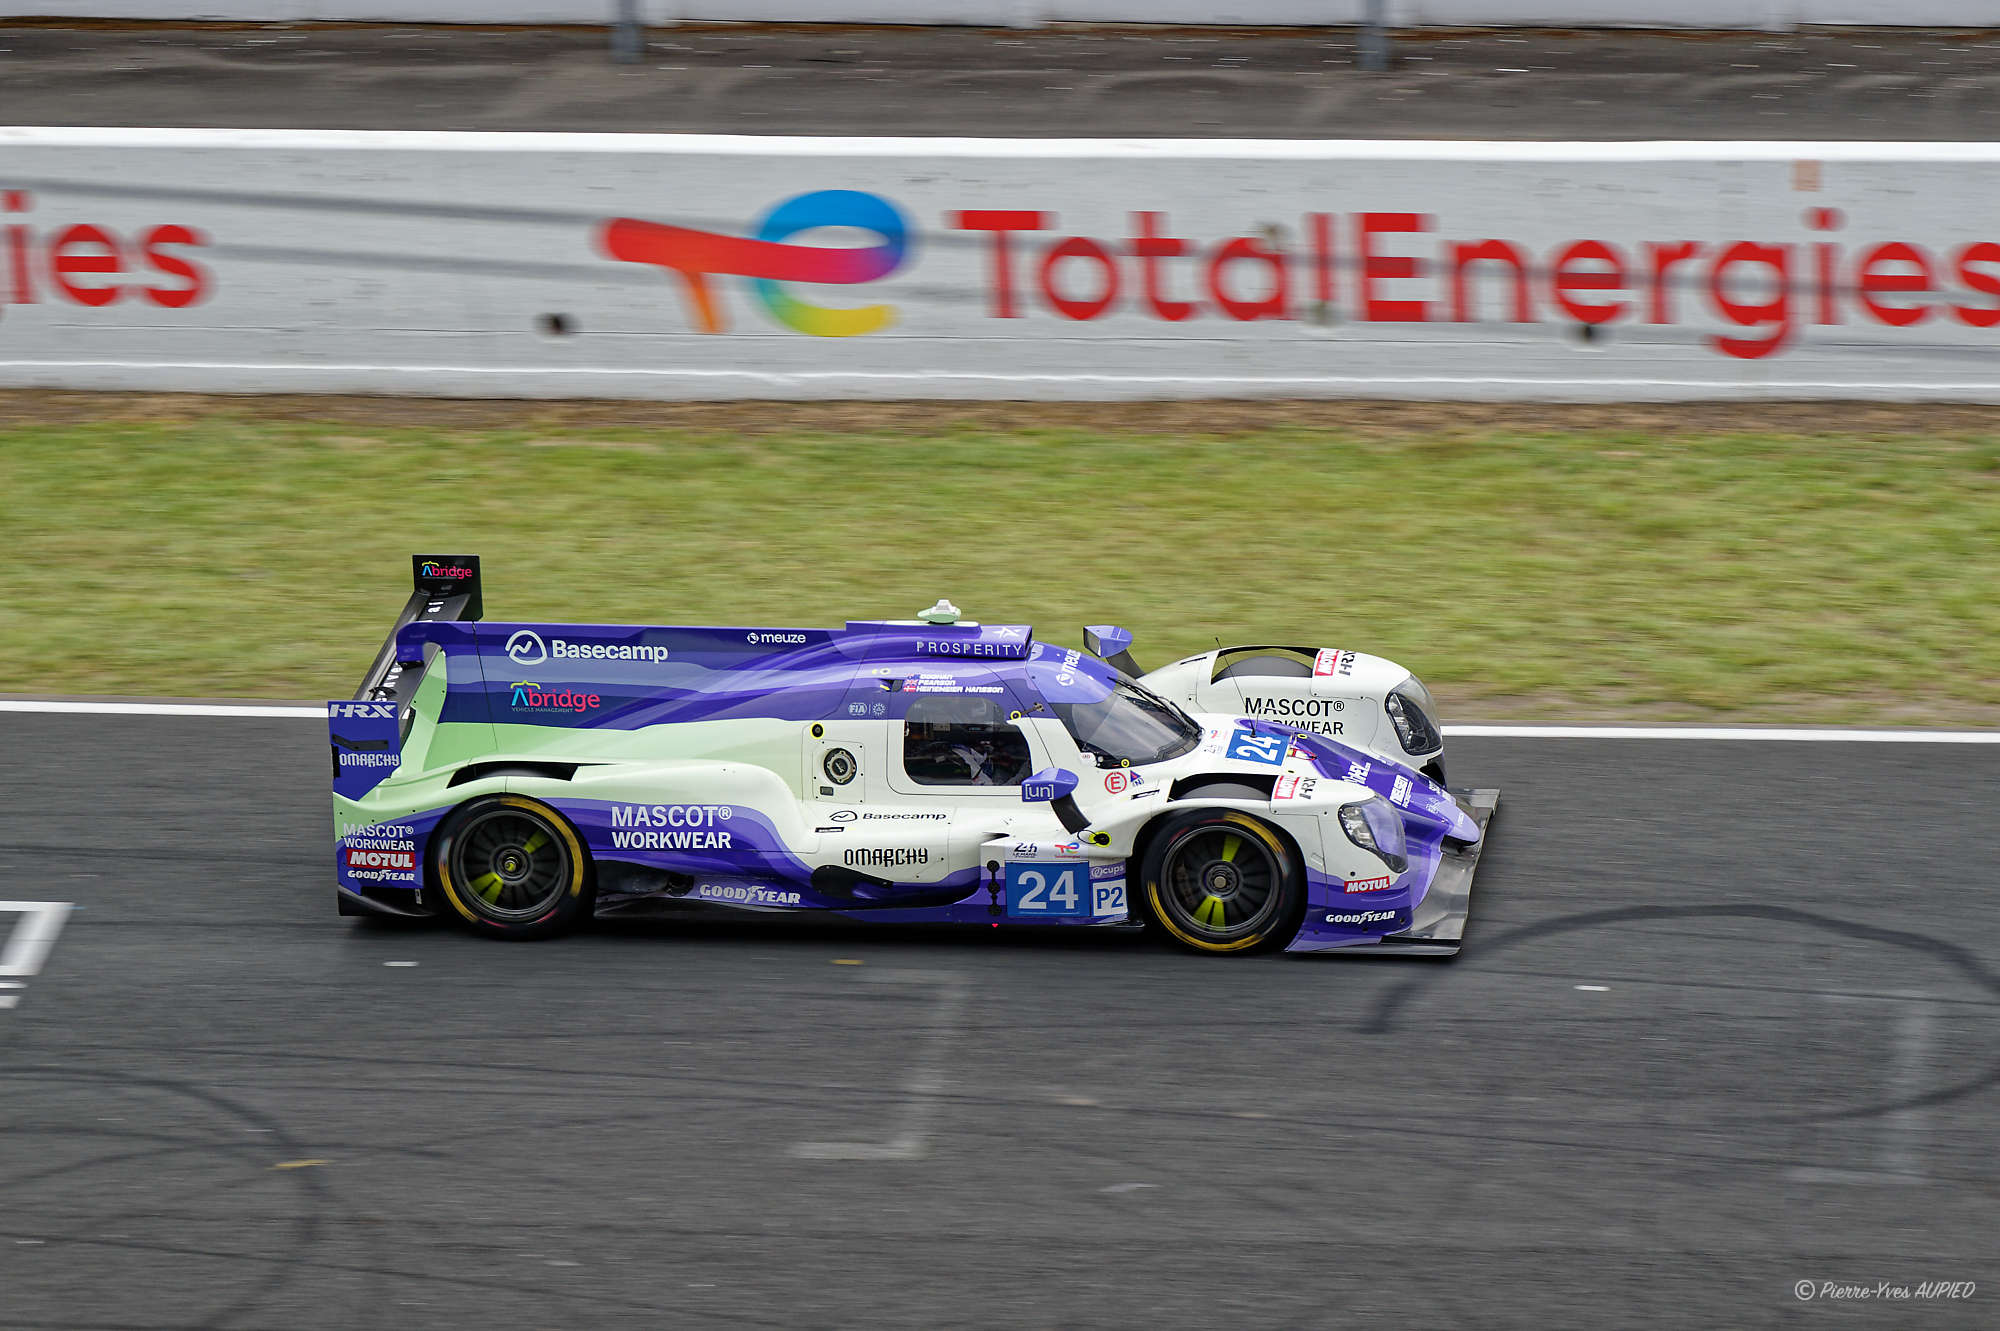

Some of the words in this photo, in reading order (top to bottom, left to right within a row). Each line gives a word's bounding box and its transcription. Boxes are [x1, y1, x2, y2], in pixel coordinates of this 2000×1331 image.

[0, 188, 217, 308] ies
[951, 209, 2000, 358] TotalEnergies
[760, 633, 806, 644] meuze
[551, 639, 669, 664] Basecamp
[916, 641, 1022, 656] PROSPERITY
[964, 686, 1004, 694] HANSSON
[328, 704, 397, 719] HRX
[849, 704, 867, 713] FIA
[1235, 734, 1282, 762] 24
[338, 752, 400, 768] OMARCHY
[862, 812, 947, 821] Basecamp
[343, 837, 415, 851] WORKWEAR
[611, 831, 732, 849] WORKWEAR
[349, 851, 414, 869] MOTUL
[844, 848, 929, 867] OMARCHY
[347, 869, 415, 882] GOODYEAR
[700, 883, 801, 904] GOODYEAR
[1017, 869, 1079, 910] 24
[1346, 879, 1390, 893] MOTUL
[1096, 886, 1124, 910] P2
[1325, 910, 1396, 925] GOODYEAR
